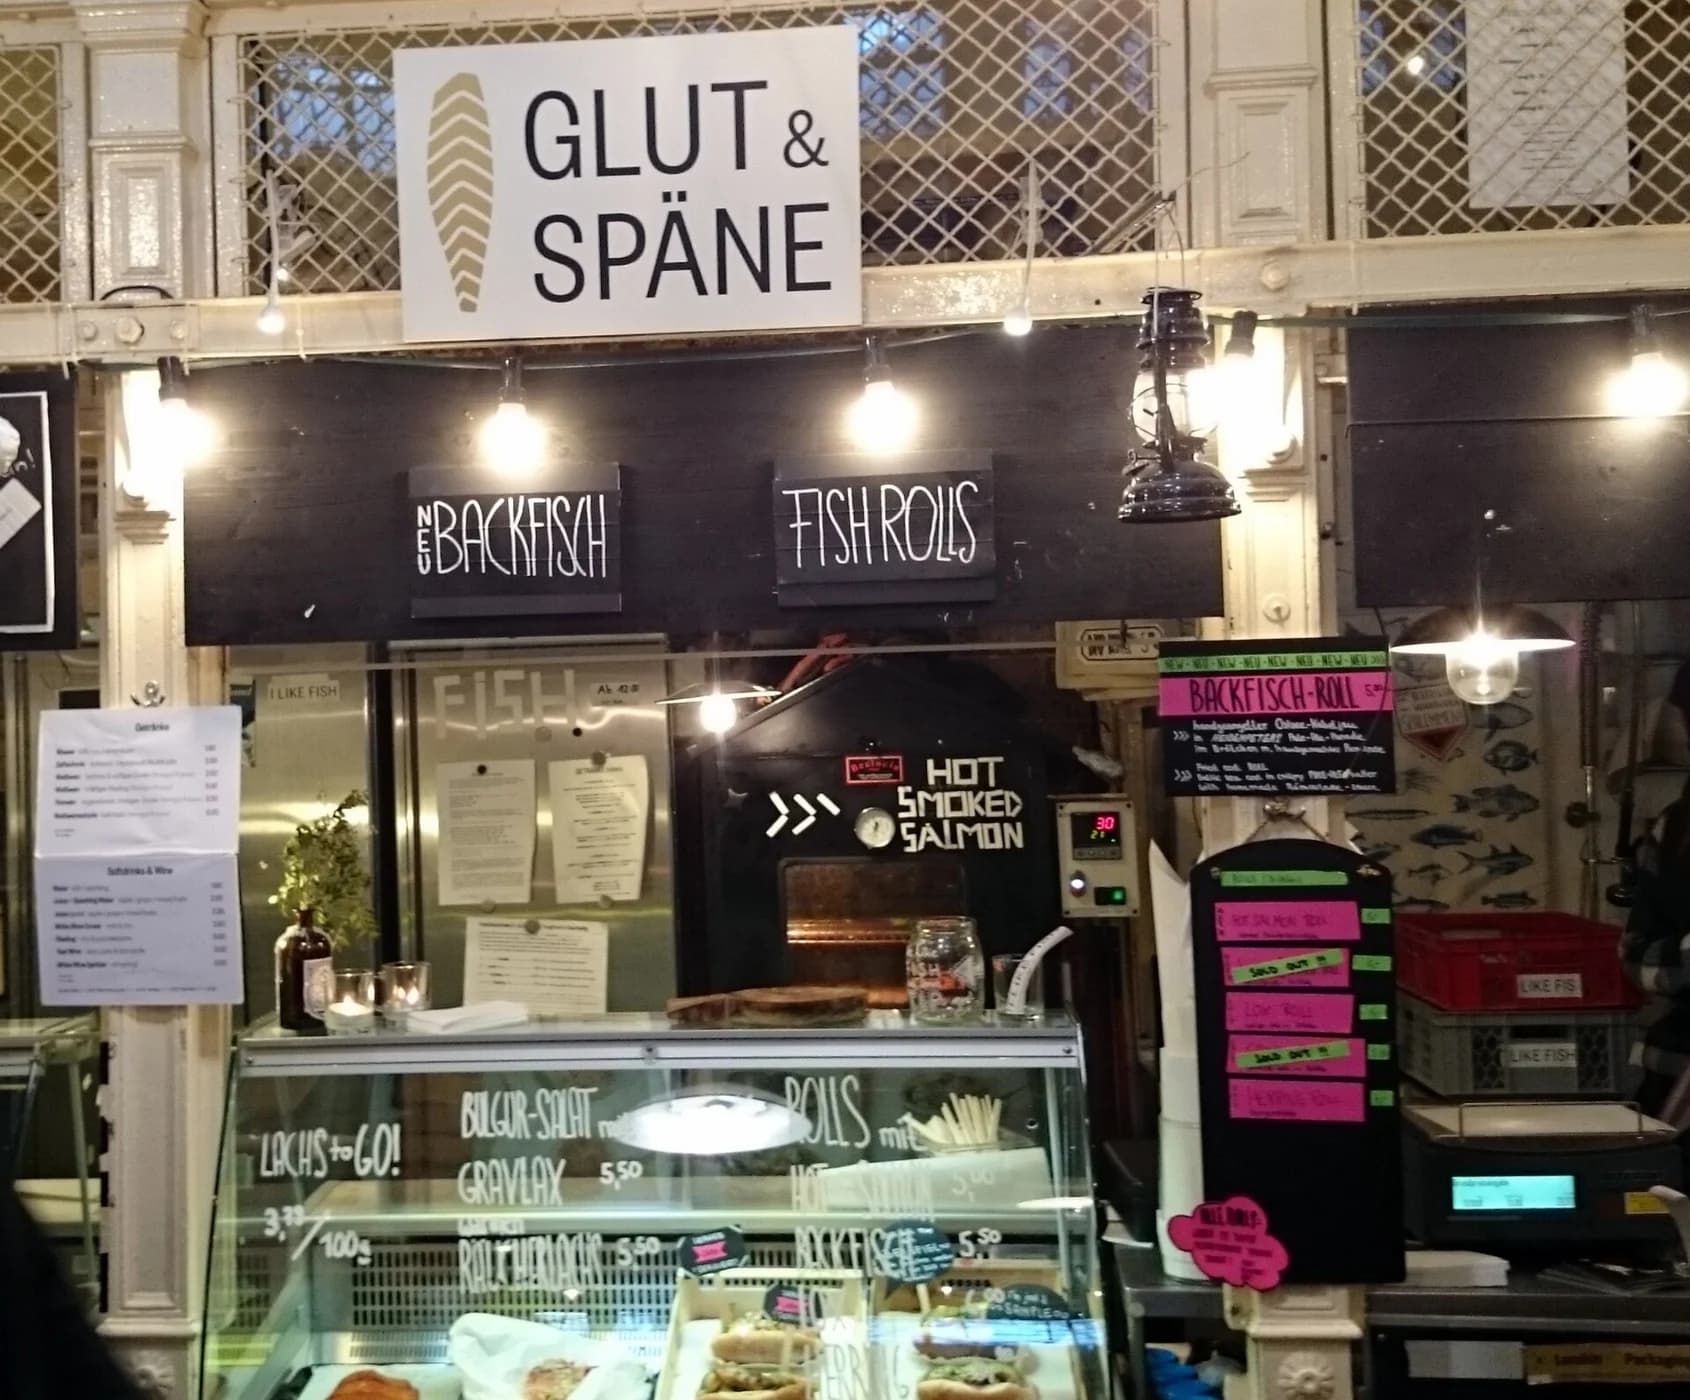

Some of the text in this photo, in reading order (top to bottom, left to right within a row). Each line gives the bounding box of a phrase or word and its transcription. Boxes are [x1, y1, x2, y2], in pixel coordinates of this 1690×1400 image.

[524, 80, 829, 180] GLUT &
[533, 190, 832, 303] SPÄNE
[417, 494, 607, 578] NEU BACKFISCH
[782, 481, 979, 568] FISH ROLLS
[1268, 655, 1287, 667] NEW
[1322, 654, 1342, 665] NEW
[278, 686, 305, 700] LIKE
[308, 685, 337, 698] FISH
[434, 669, 577, 740] FISH
[1189, 676, 1360, 713] BACKFISCH-ROLL
[926, 756, 1004, 787] HOT
[897, 786, 1023, 819] SMOKED
[900, 820, 1024, 853] SALMON
[1096, 817, 1115, 830] 30
[1249, 965, 1278, 978] SOLD
[1286, 959, 1309, 971] OUT
[1521, 979, 1551, 992] LIKE
[461, 1086, 599, 1140] BULGUR-SALAT
[785, 1074, 872, 1149] ROLLS
[260, 1123, 402, 1179] LACHS to GO!
[458, 1156, 644, 1206] GRAVLAX 5,50
[790, 1162, 830, 1214] HOT
[617, 1236, 661, 1272] 5,50
[958, 1228, 1002, 1260] 5,50
